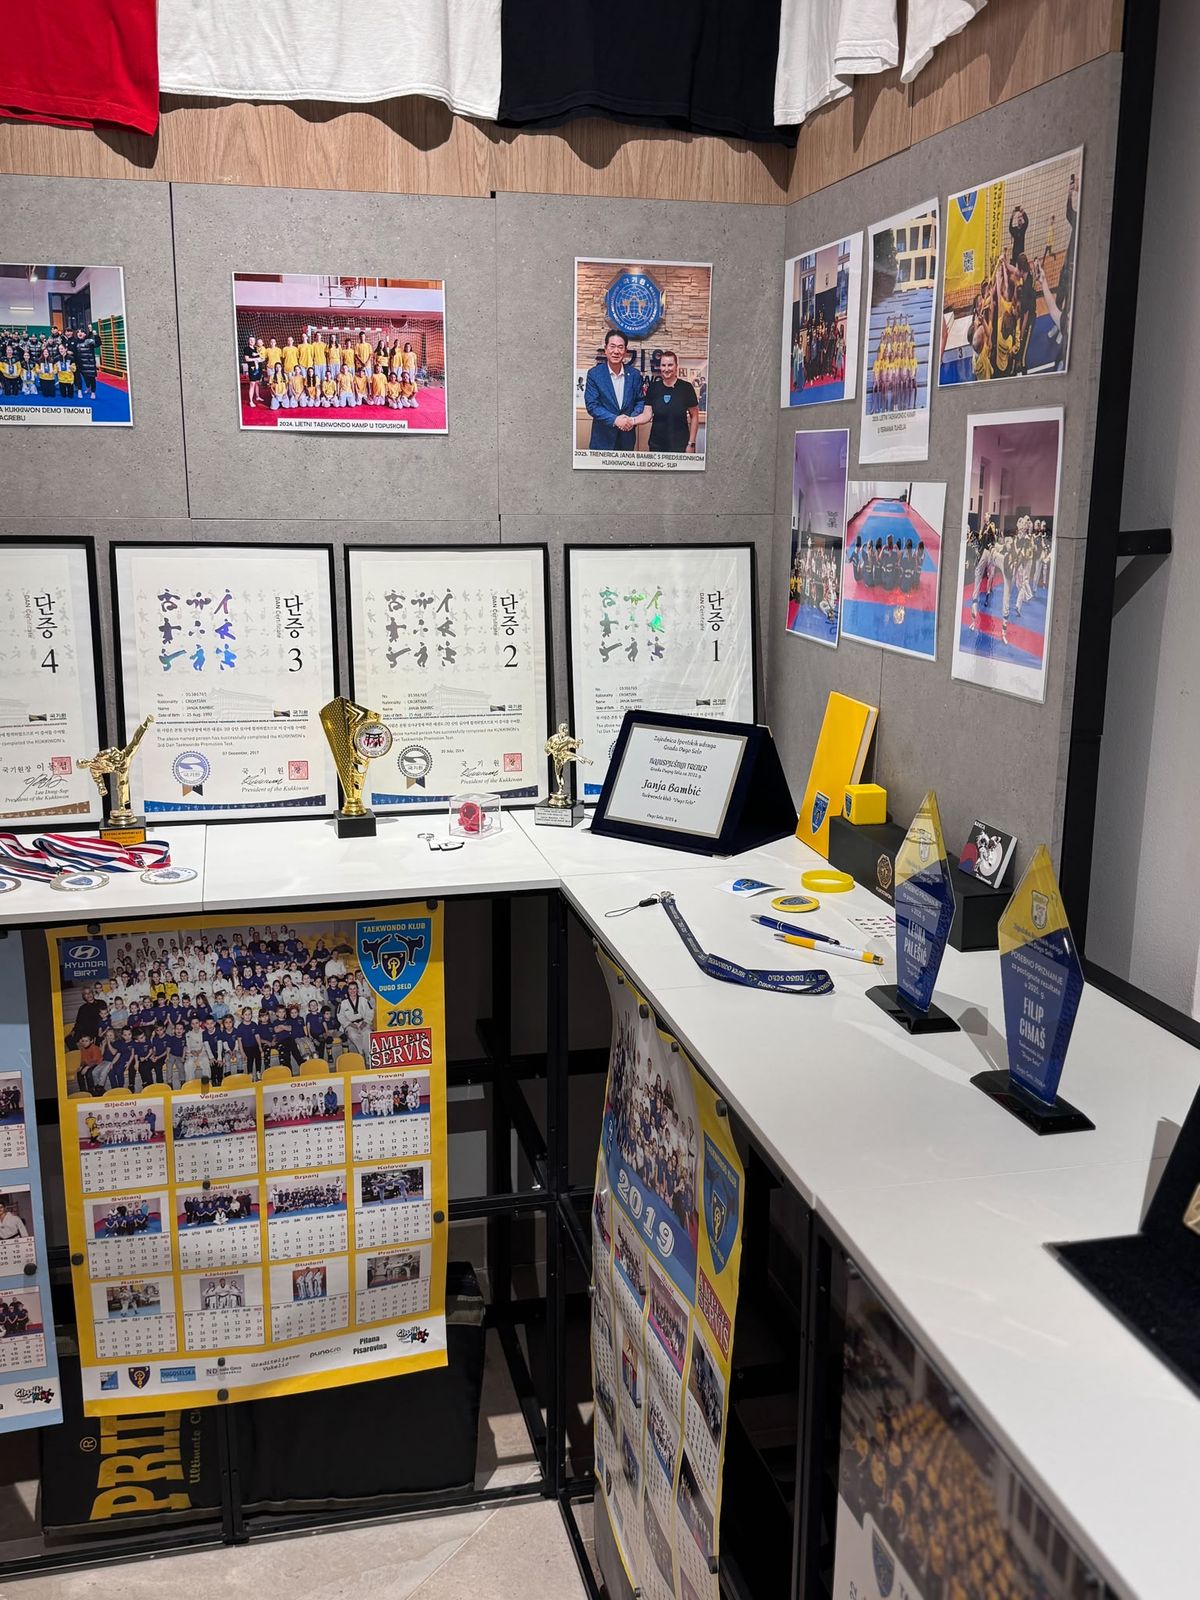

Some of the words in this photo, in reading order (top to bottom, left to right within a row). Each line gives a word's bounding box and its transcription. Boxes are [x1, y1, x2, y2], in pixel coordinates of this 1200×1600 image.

[34, 593, 58, 639] 단증
[283, 595, 304, 638] 단증
[500, 594, 519, 636] 단증
[707, 591, 724, 632] 단증
[41, 649, 59, 673] 4
[288, 648, 303, 672] 3
[503, 644, 518, 668] 2
[712, 640, 720, 661] 1
[641, 779, 666, 792] Janja
[668, 783, 701, 796] Bambić
[362, 924, 406, 933] TAEKWONDO
[64, 960, 107, 969] HYUNDAI
[1011, 951, 1034, 969] POSEBNO
[1035, 962, 1063, 986] PRIZNANJE
[378, 984, 395, 992] DUGO
[386, 1008, 424, 1028] 2018
[1023, 997, 1044, 1024] FILIP
[371, 1038, 431, 1067] SERVIS
[617, 1169, 674, 1258] 2019
[699, 1297, 730, 1356] SERVIS
[353, 1343, 387, 1355] Pisarovina
[360, 1335, 380, 1344] Pilana
[90, 1410, 192, 1520] PRI
[190, 1430, 202, 1485] Ultimate
